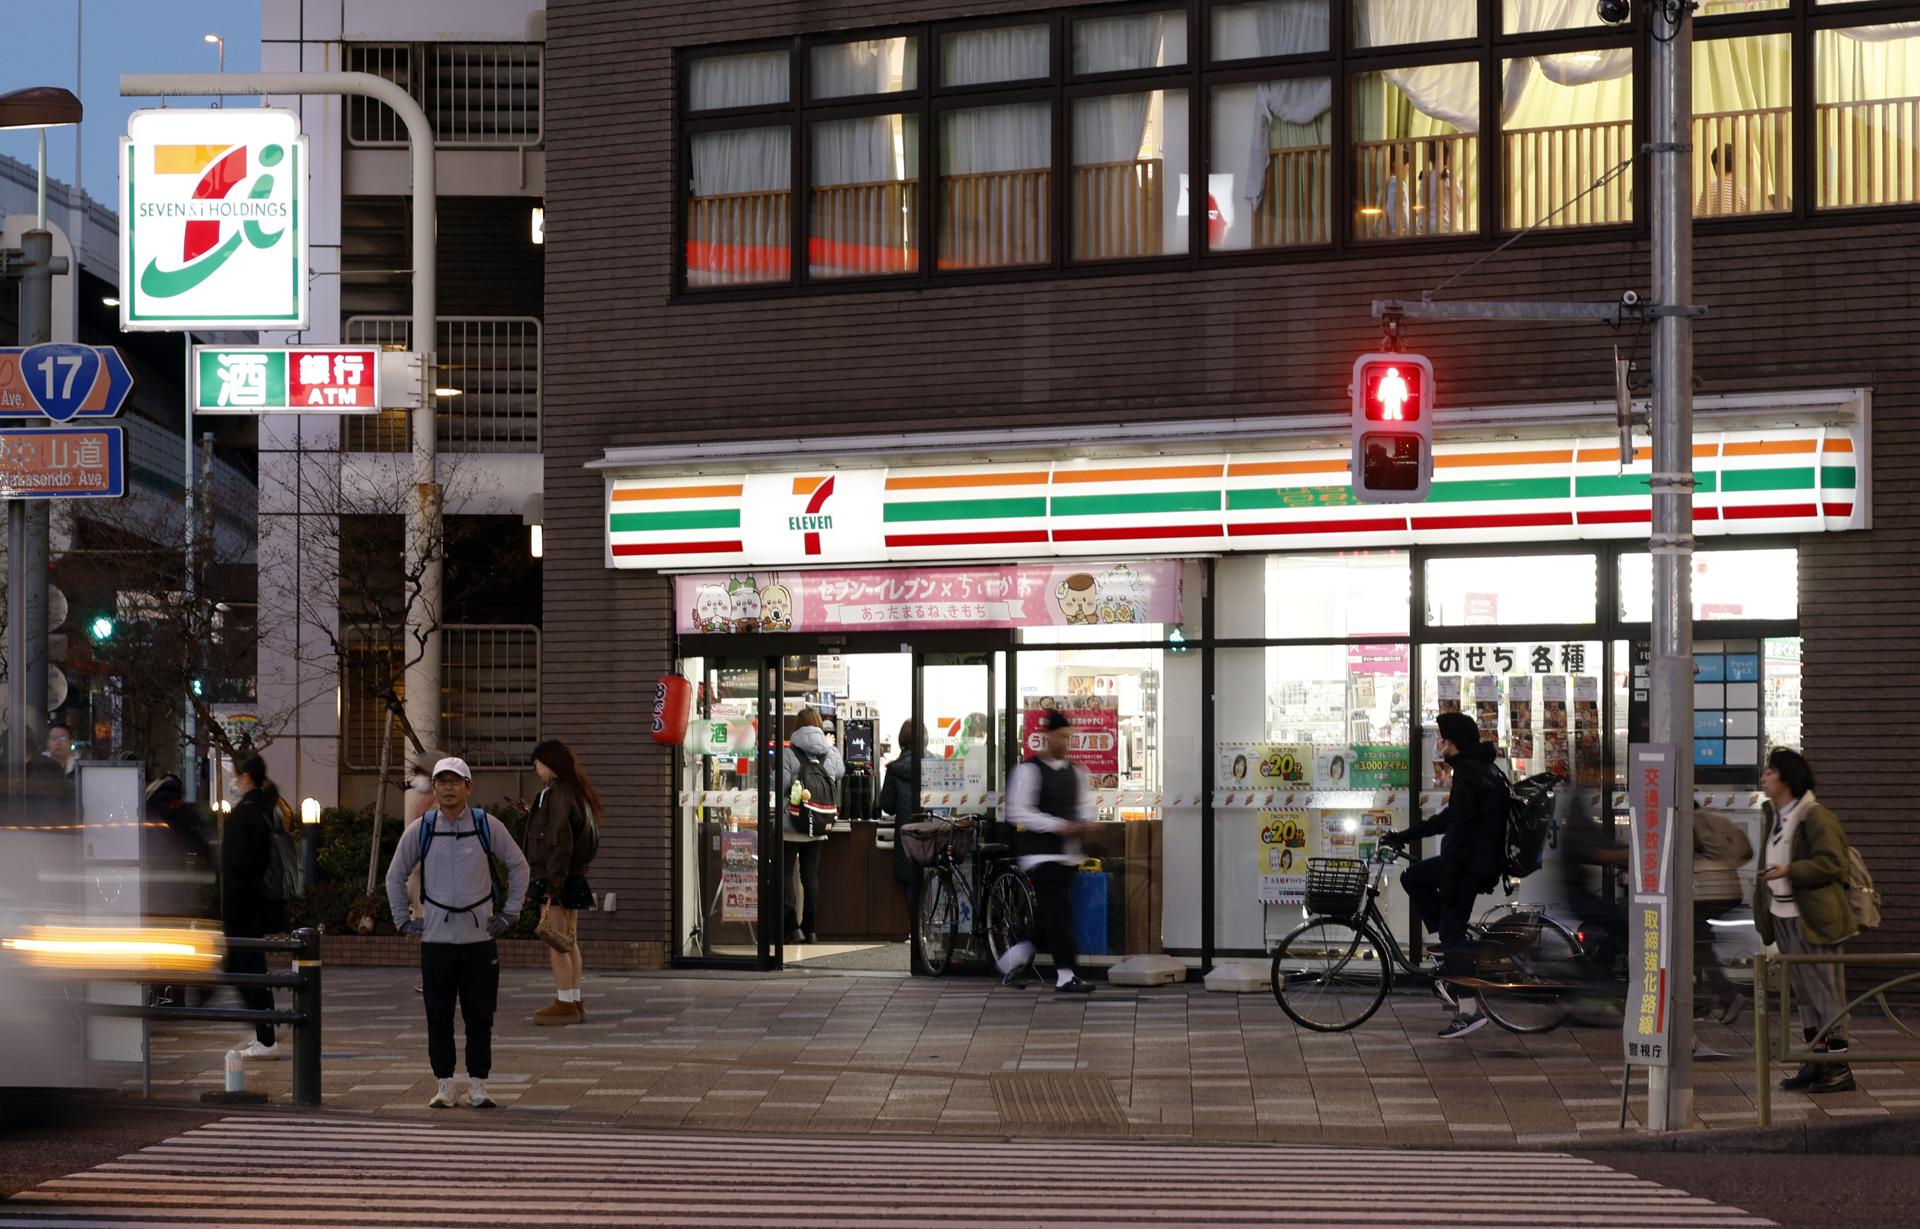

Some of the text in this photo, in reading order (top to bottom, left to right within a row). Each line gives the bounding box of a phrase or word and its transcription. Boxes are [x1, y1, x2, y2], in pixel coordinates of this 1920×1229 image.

[210, 202, 287, 217] HOLDINGS
[38, 356, 83, 400] 17
[216, 353, 269, 407] 酒
[300, 355, 364, 385] 銀行
[1, 389, 25, 407] Ave.
[307, 387, 357, 405] ATM
[79, 470, 107, 488] Ave.
[1438, 644, 1585, 674] おせち 各種
[710, 722, 728, 743] 酒
[1643, 767, 1660, 894] 交通事故多発
[1638, 909, 1659, 1036] 取締強化路線
[1628, 1042, 1662, 1058] 警視庁
